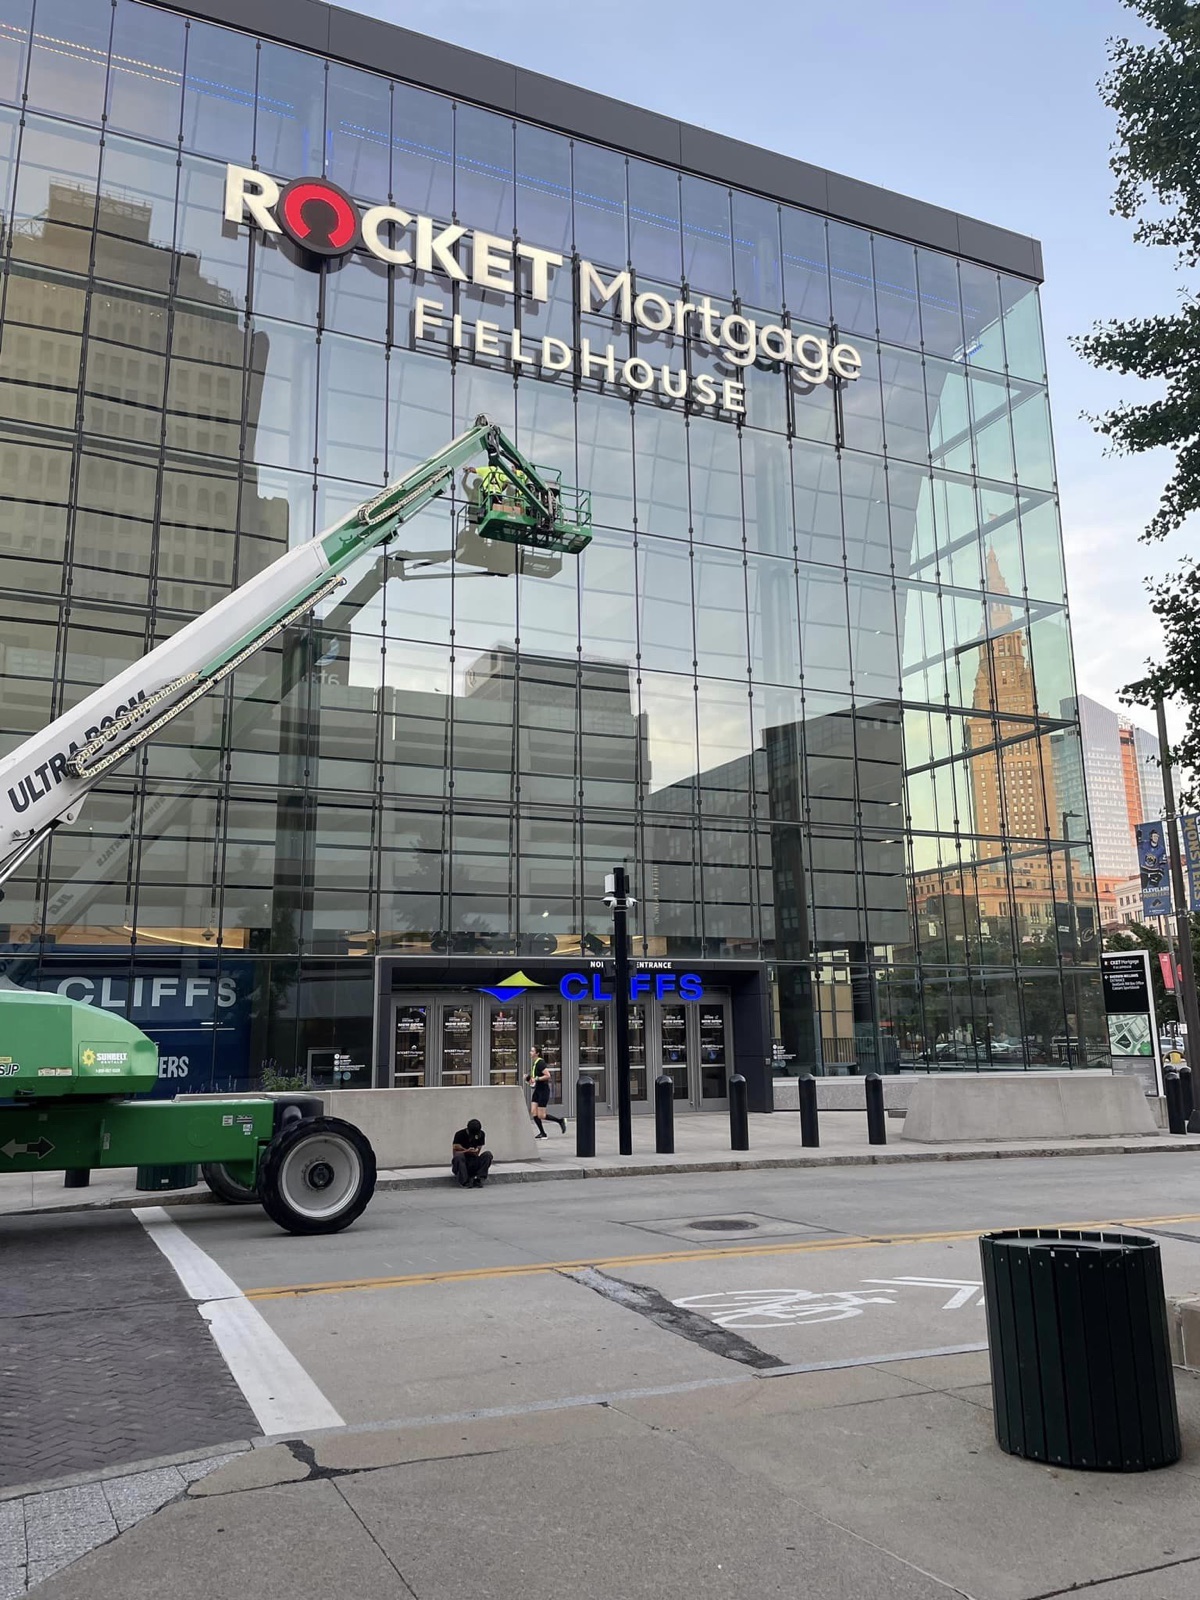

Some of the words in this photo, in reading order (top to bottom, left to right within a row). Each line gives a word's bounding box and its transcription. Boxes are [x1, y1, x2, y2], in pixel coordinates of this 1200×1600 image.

[225, 163, 562, 303] ROCKET
[579, 260, 862, 385] Mortgage
[414, 296, 746, 413] FIELDHOUSE
[637, 961, 672, 969] ENTRANCE
[56, 976, 237, 1008] CLIFFS
[560, 972, 704, 1001] CLFFS
[158, 1055, 189, 1078] ERS
